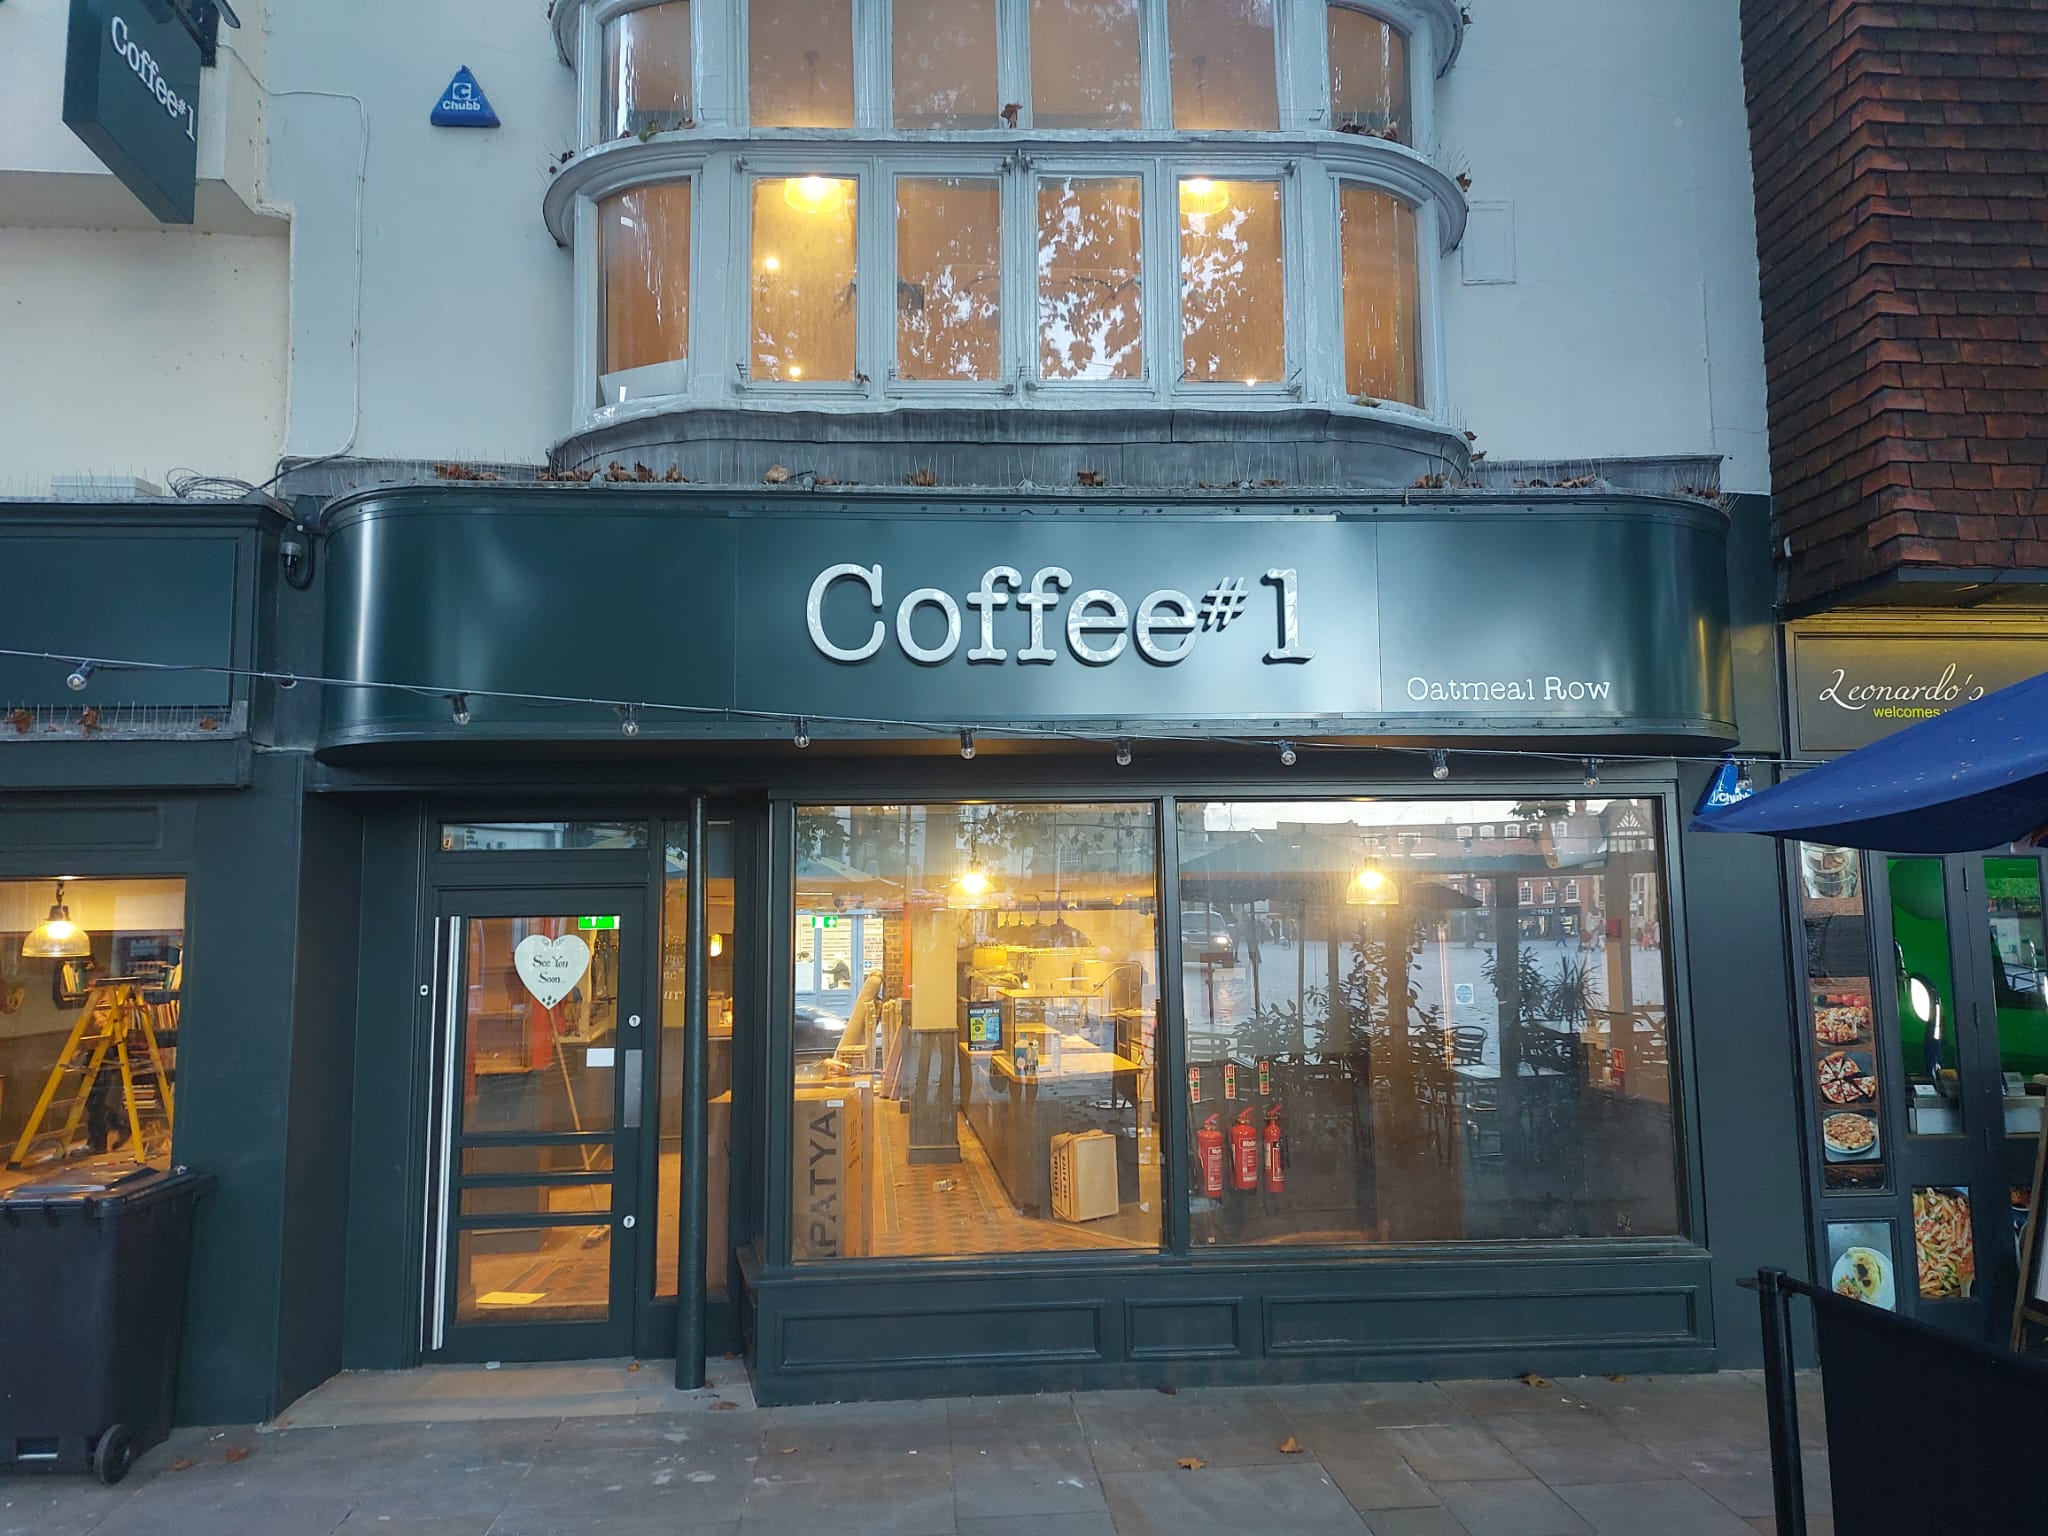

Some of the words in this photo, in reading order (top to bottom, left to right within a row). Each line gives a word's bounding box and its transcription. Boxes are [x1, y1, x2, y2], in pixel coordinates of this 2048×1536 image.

[442, 100, 481, 111] Chubb
[1407, 676, 1536, 701] Oatmeal
[1543, 676, 1611, 701] Row
[1872, 705, 1941, 719] welcomes
[532, 954, 551, 968] See
[552, 955, 569, 968] You
[809, 1109, 837, 1257] PATYA
